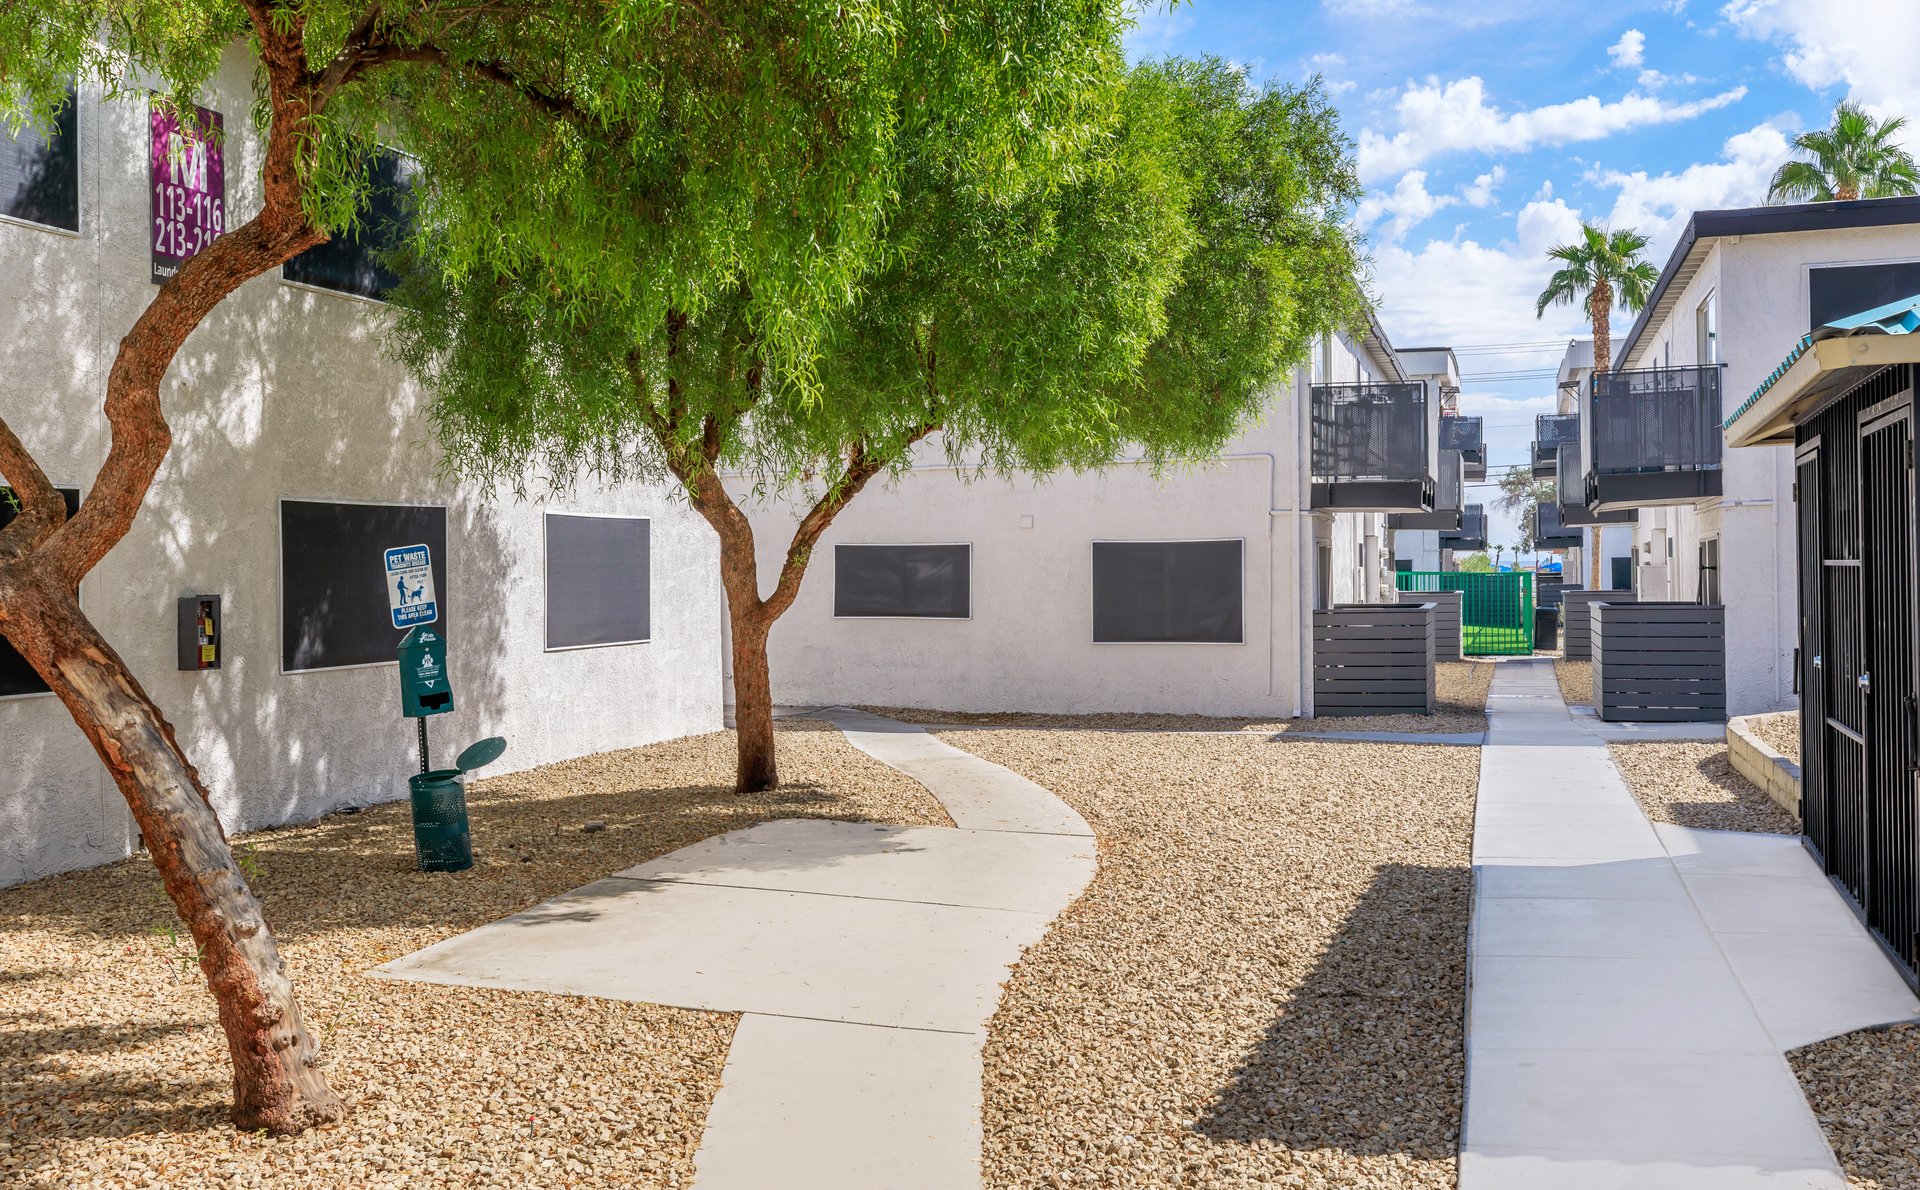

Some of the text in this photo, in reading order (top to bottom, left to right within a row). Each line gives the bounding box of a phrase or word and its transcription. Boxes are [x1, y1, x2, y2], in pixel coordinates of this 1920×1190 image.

[170, 132, 207, 193] M
[156, 183, 222, 231] 113-116
[155, 217, 222, 257] 213-21
[389, 551, 426, 564] PET WASTE
[401, 606, 416, 614] PLEASE
[408, 611, 419, 619] AREA
[419, 609, 432, 617] CLEAN
